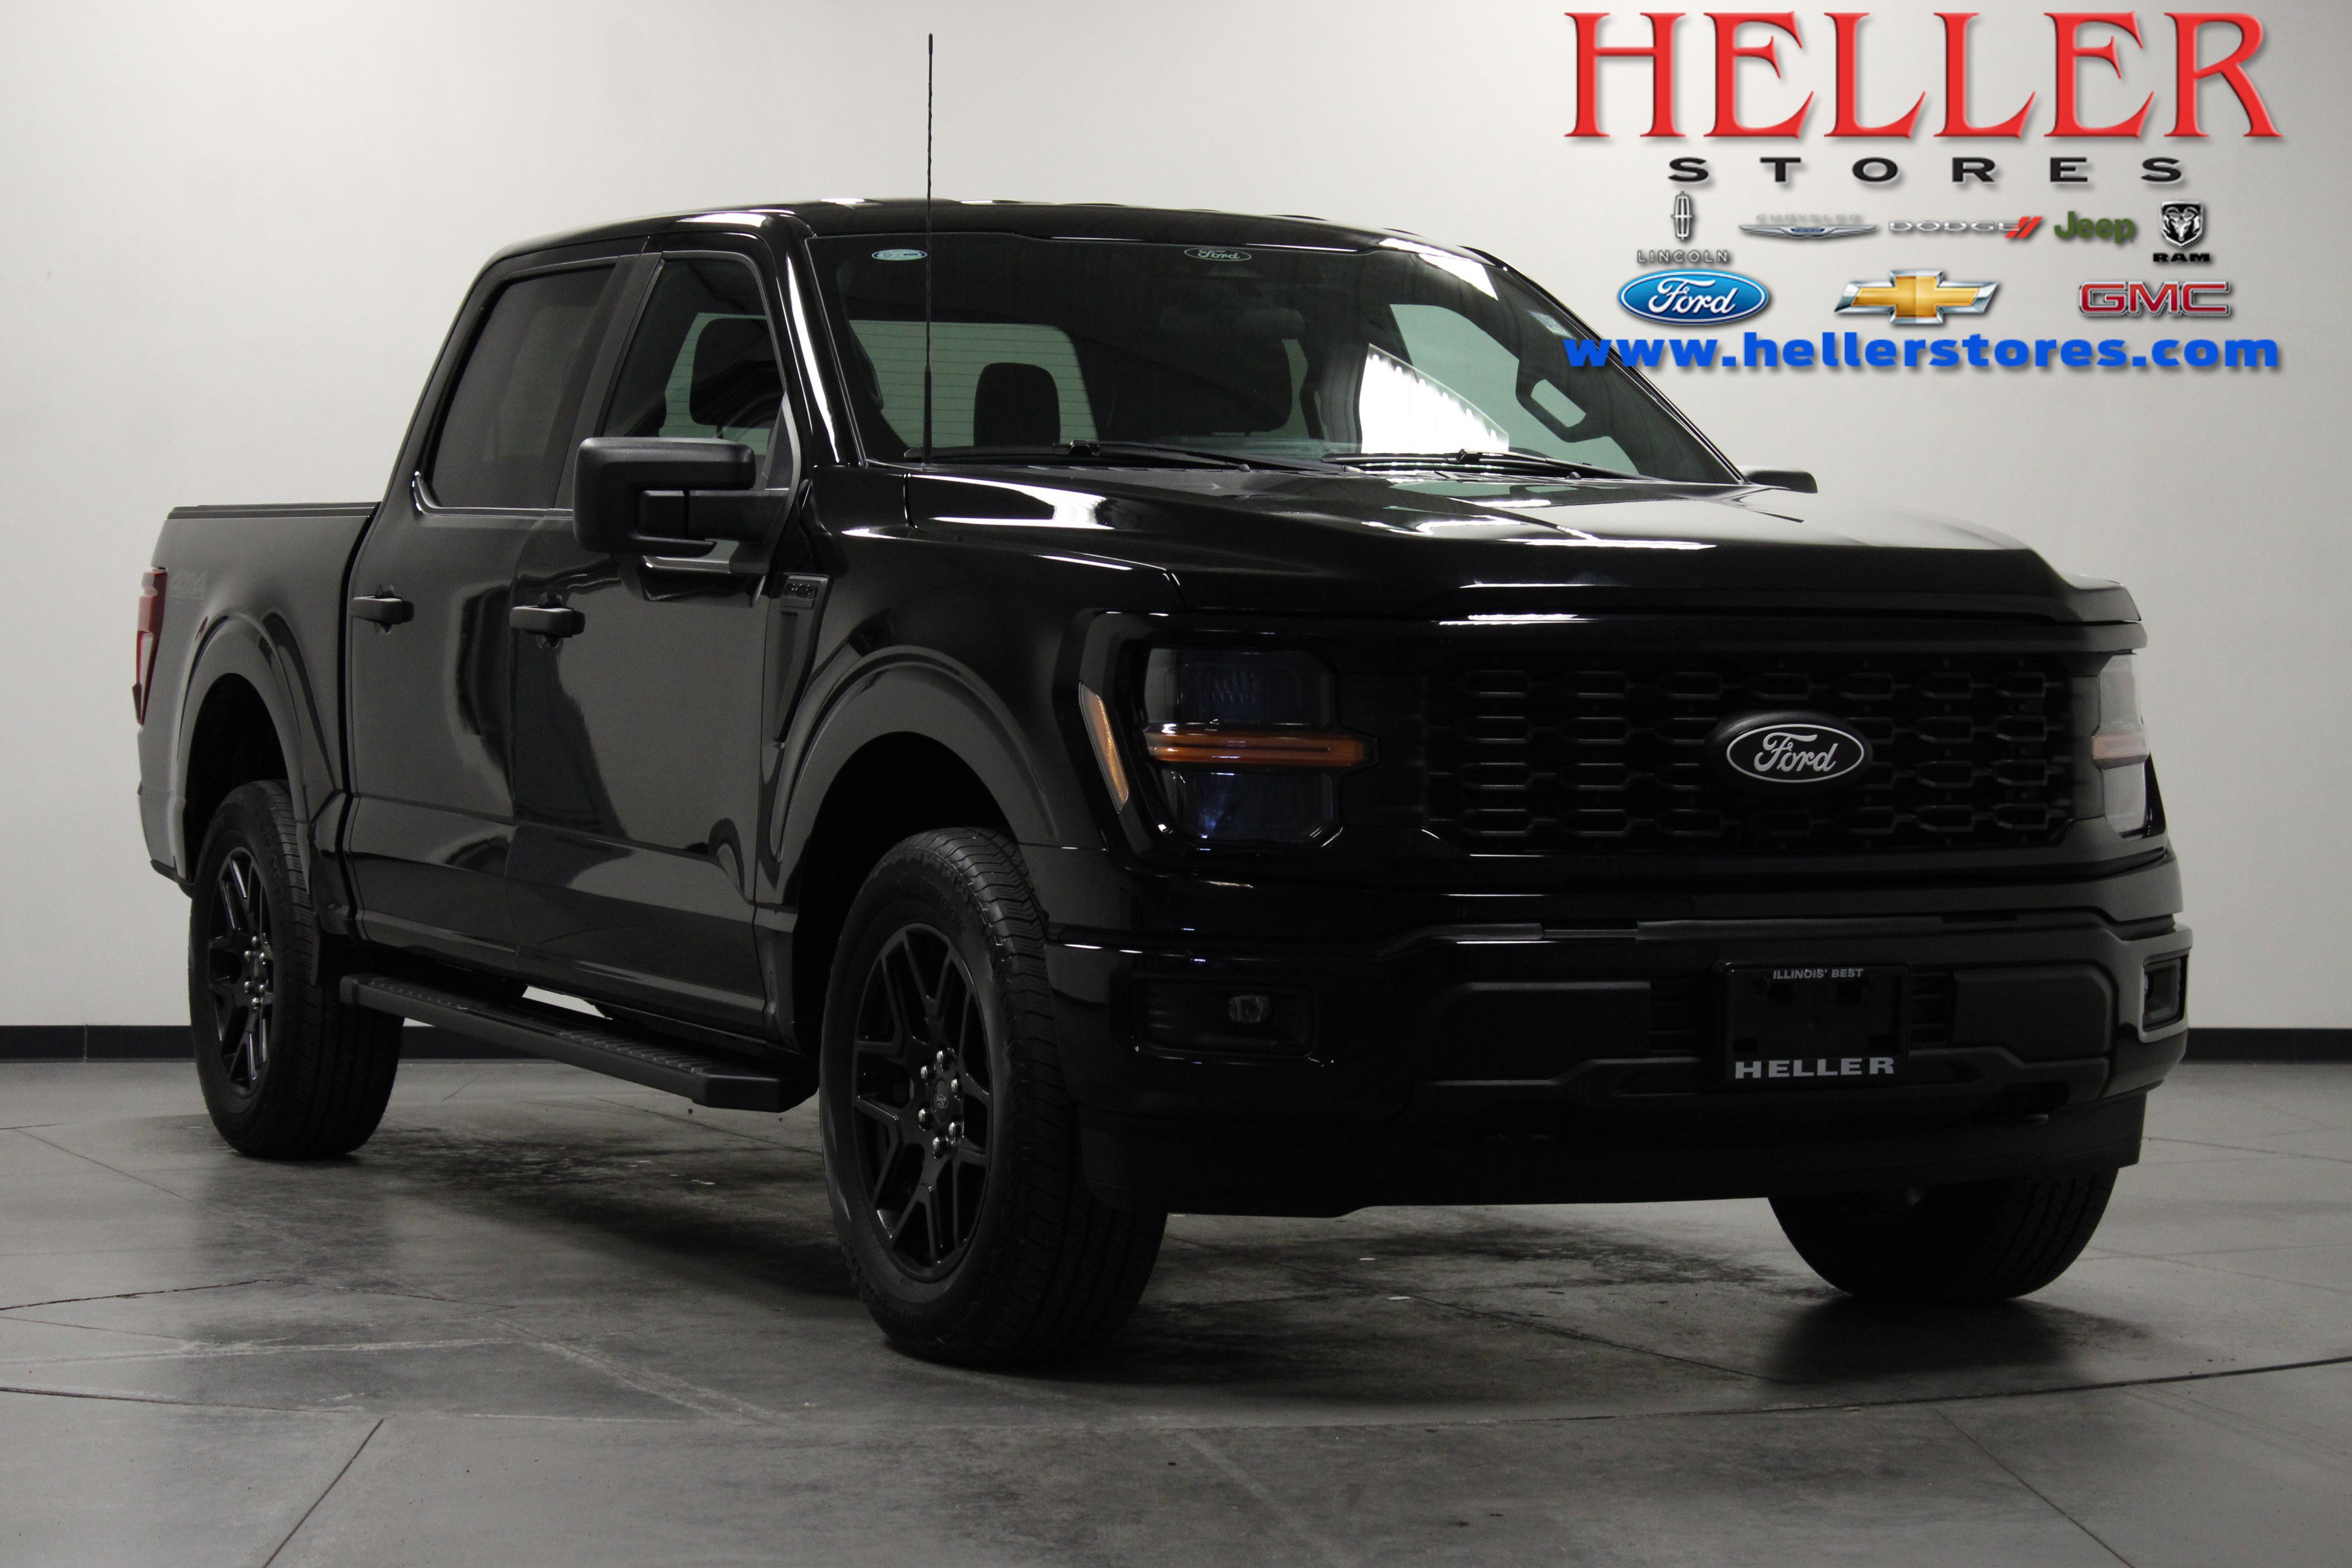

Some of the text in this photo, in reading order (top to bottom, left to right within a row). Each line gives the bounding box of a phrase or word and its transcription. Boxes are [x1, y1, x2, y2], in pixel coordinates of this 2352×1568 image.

[1197, 249, 1240, 260] Ford
[1754, 731, 1838, 772] Ford
[1831, 968, 1864, 978] BEST
[1734, 1057, 1894, 1079] HELLER
